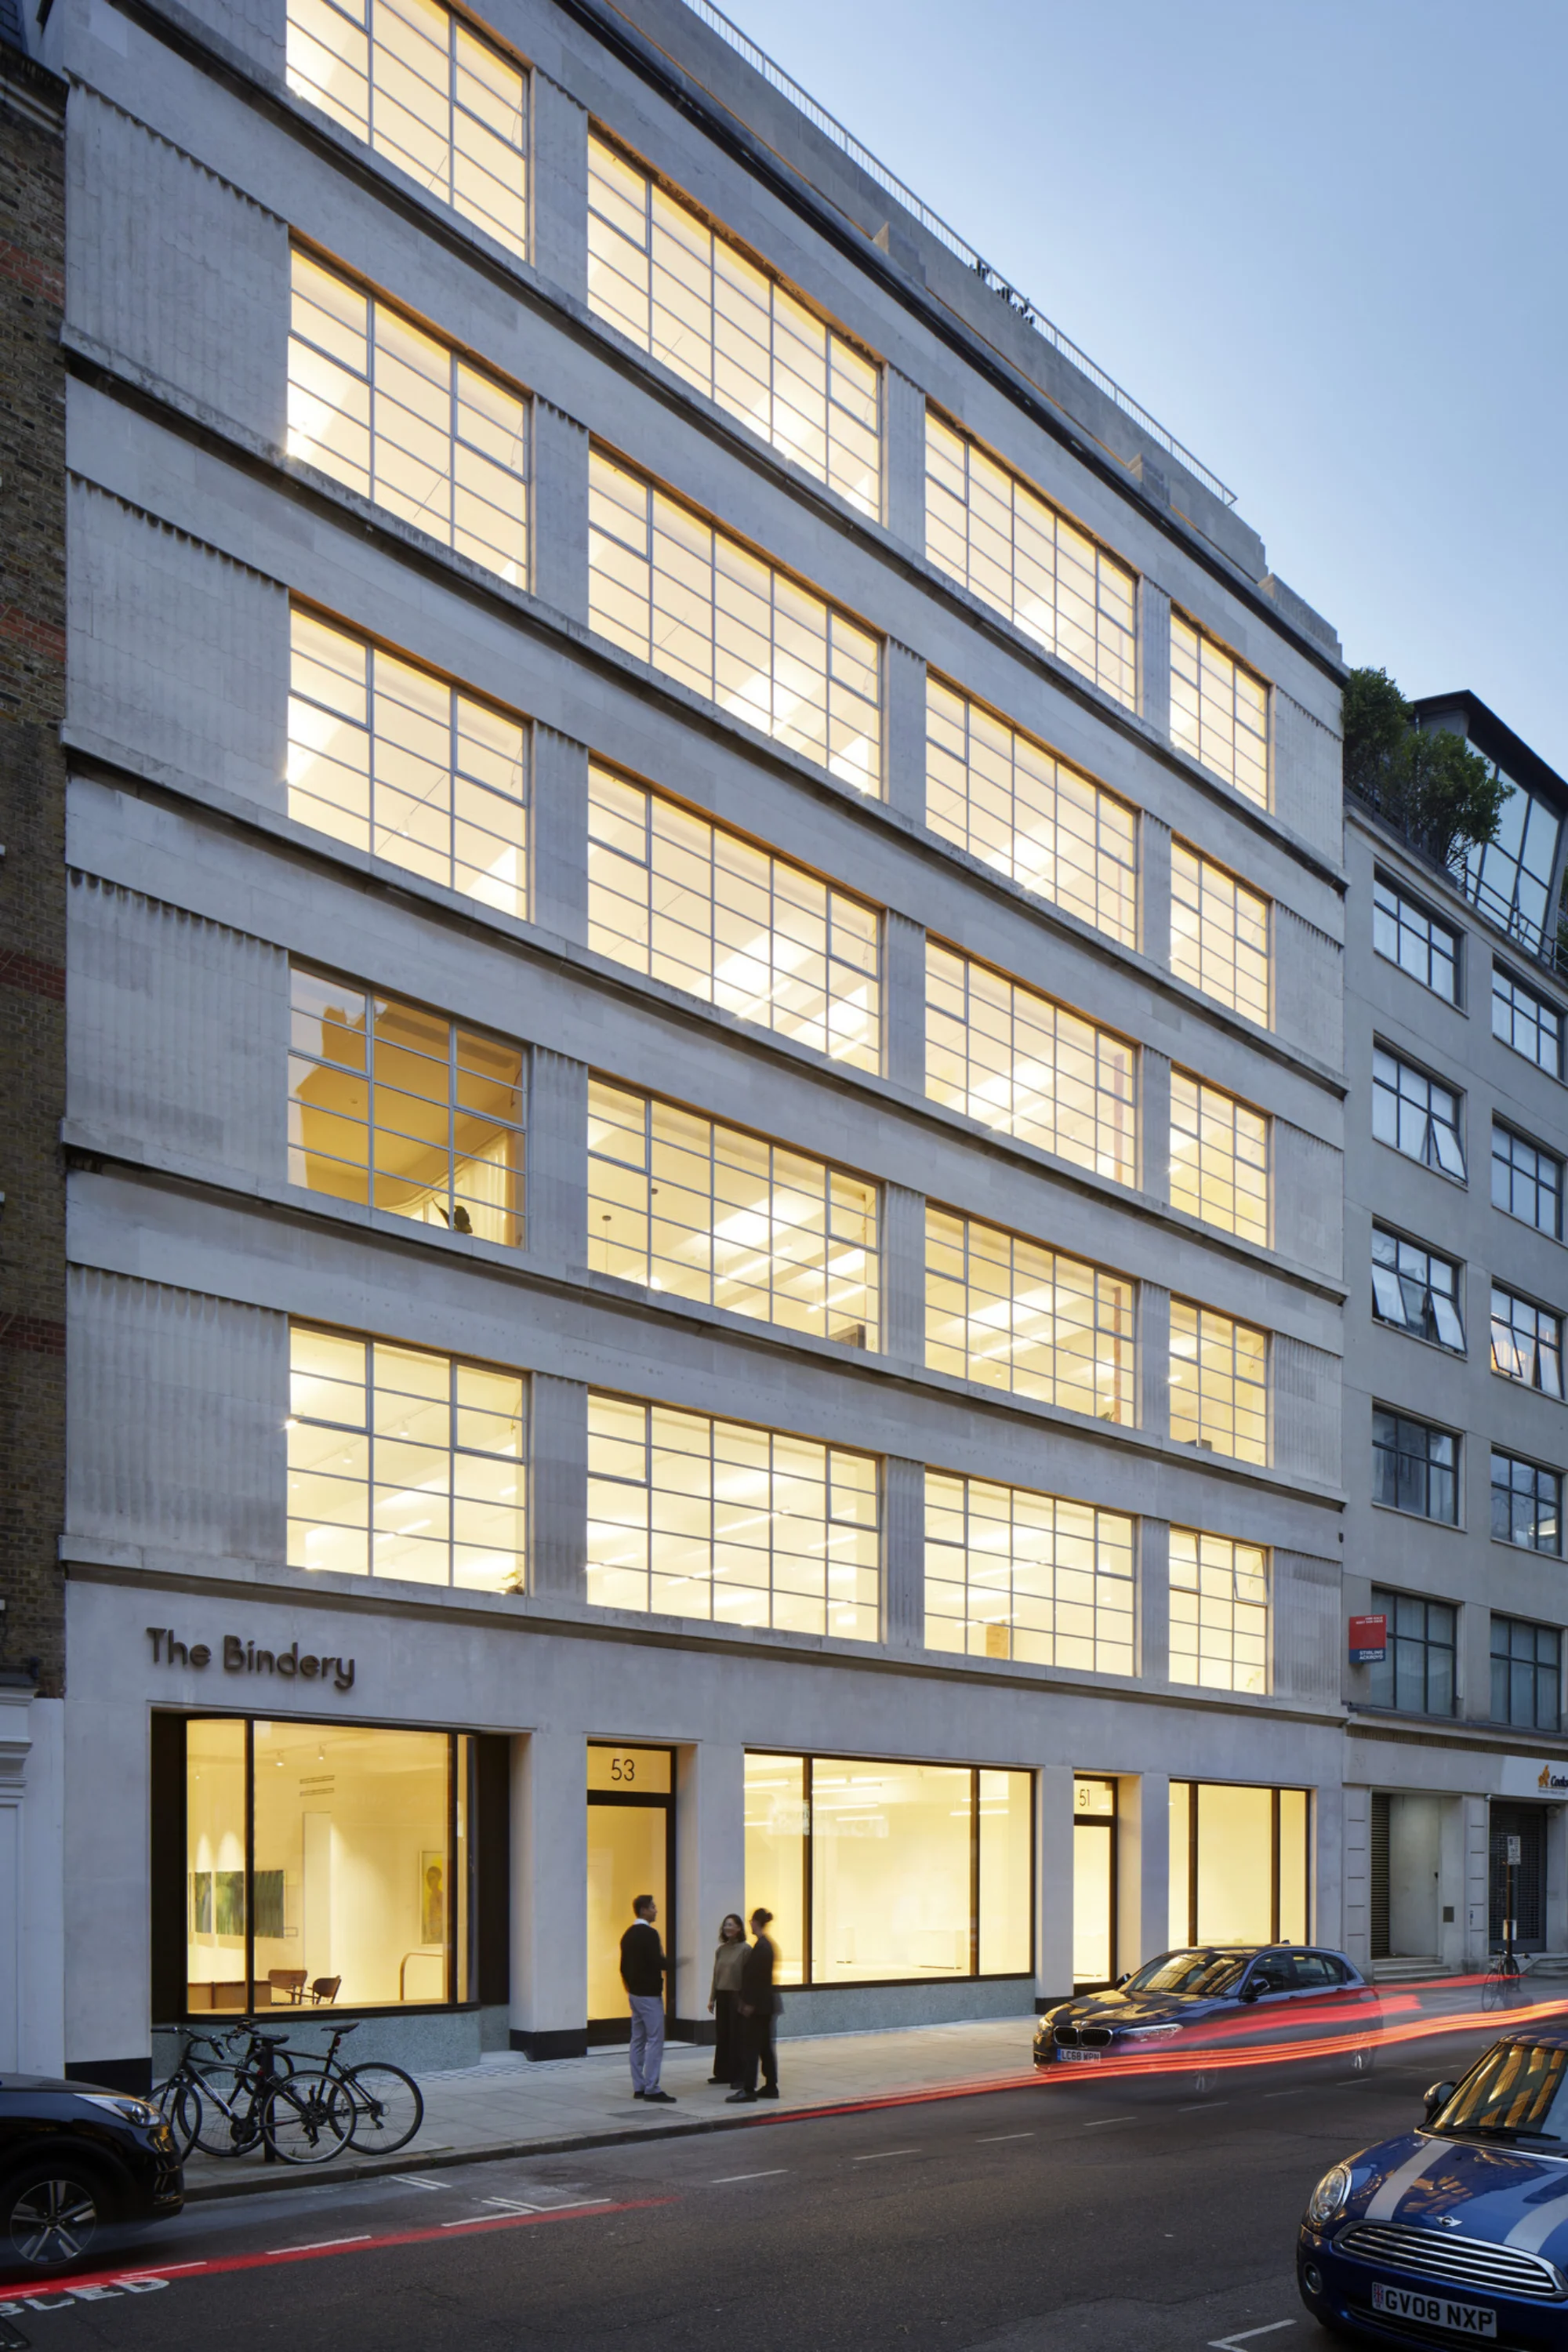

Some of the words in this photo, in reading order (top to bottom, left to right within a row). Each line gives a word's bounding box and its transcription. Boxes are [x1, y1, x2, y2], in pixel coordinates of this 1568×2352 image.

[146, 1627, 212, 1667] The
[223, 1634, 355, 1690] Bindery
[612, 1759, 634, 1781] 53
[1080, 1788, 1091, 1806] 51
[1062, 2050, 1081, 2061] LC68
[1385, 2289, 1441, 2321] GV08
[1446, 2304, 1493, 2332] NXP
